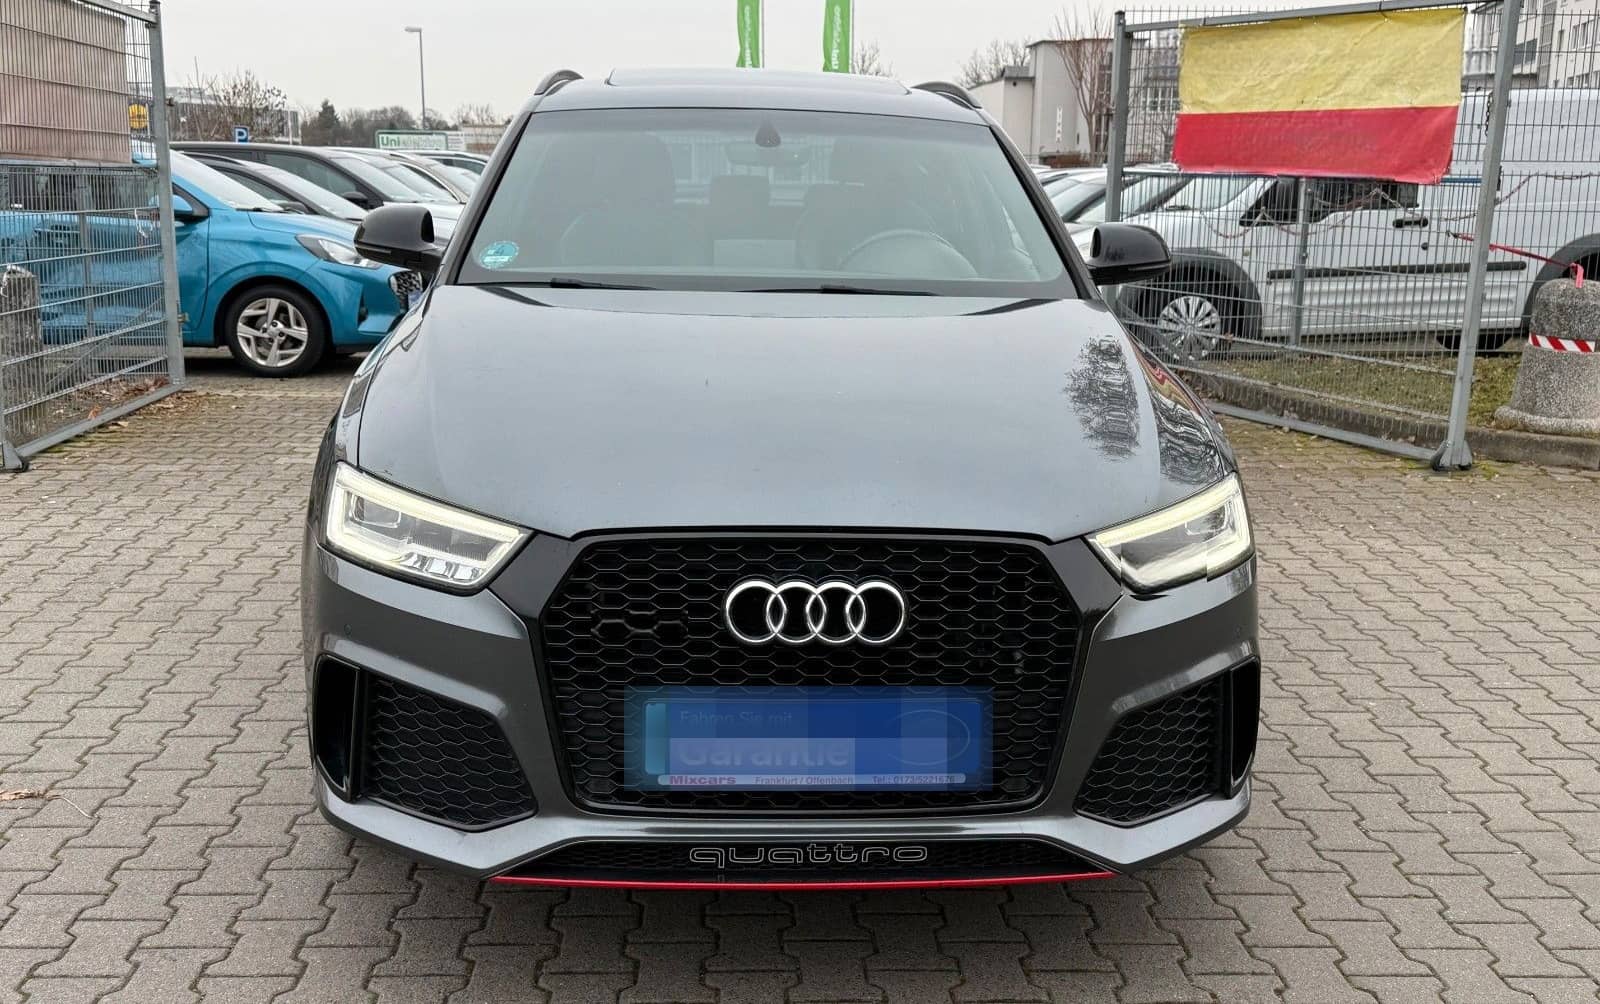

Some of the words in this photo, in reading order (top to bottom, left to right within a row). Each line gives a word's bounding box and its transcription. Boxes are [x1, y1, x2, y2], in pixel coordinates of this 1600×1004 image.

[235, 128, 247, 144] P
[679, 710, 737, 722] Fahren
[739, 710, 763, 722] Sie
[768, 710, 793, 722] mit
[679, 739, 850, 768] Garantie
[670, 775, 737, 786] Mixcars
[754, 775, 798, 786] Frankfurt
[806, 775, 854, 786] Offenbach
[689, 843, 928, 869] quattro
